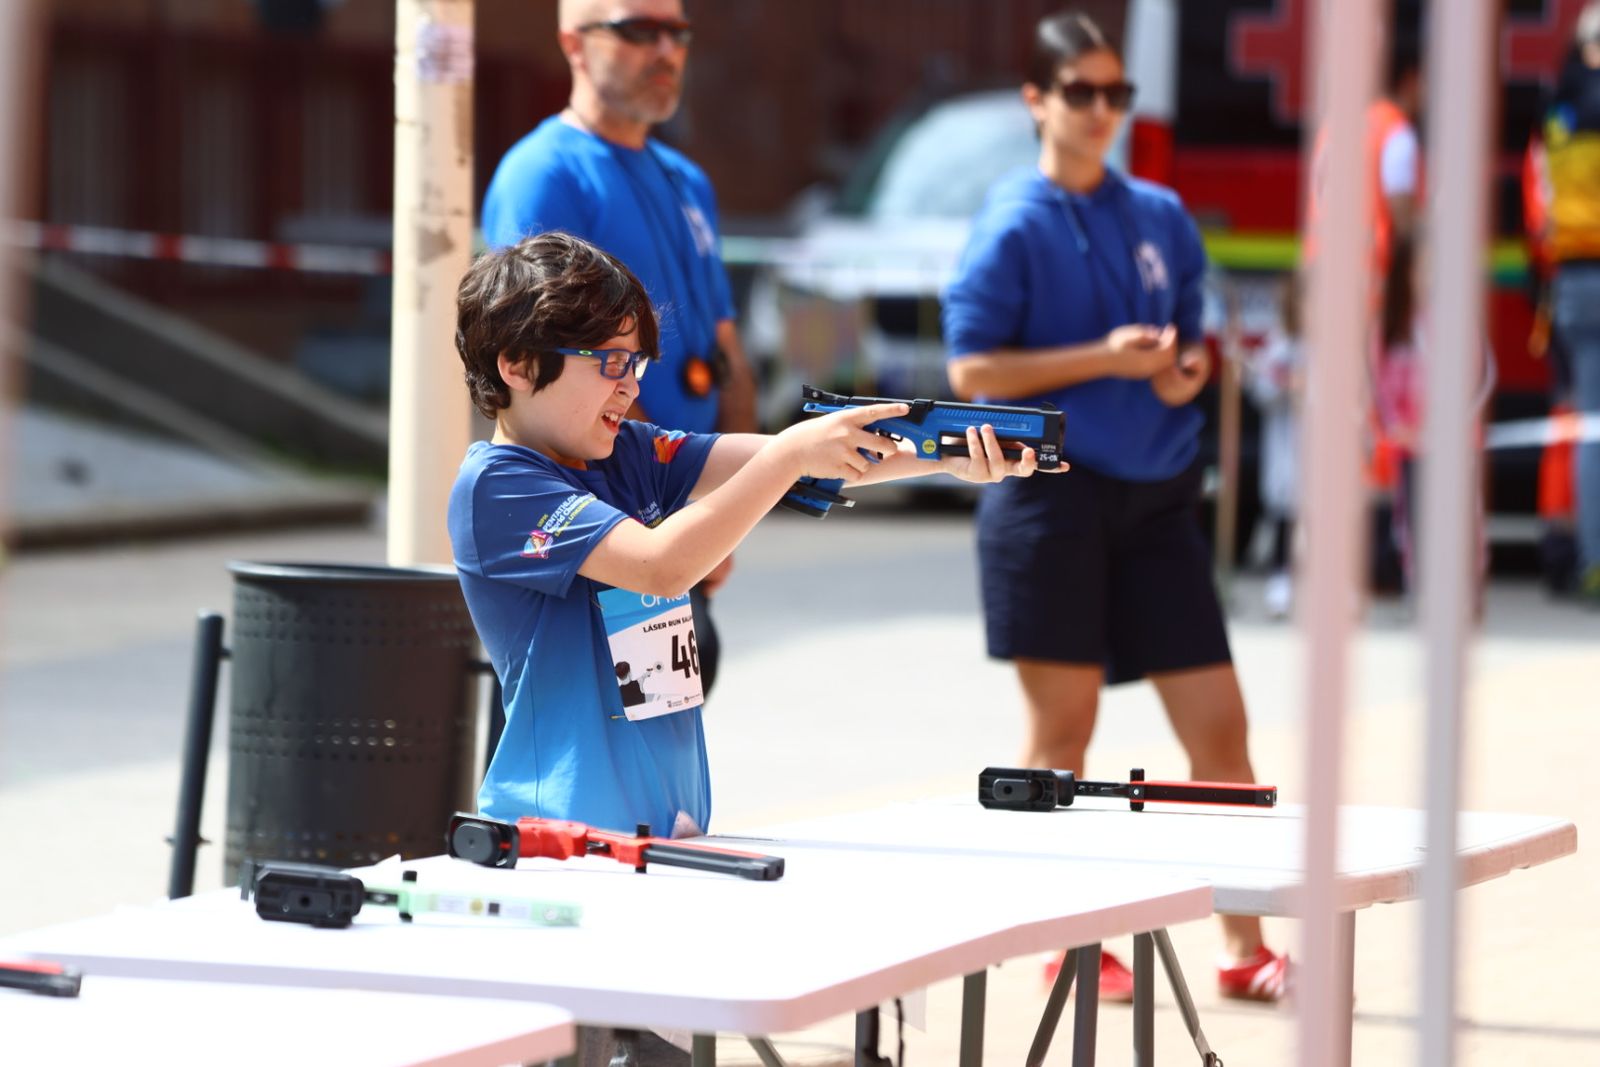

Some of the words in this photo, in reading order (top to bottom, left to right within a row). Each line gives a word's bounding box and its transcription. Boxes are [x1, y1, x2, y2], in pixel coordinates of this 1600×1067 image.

[542, 493, 578, 532] PENTATHLON
[643, 621, 667, 633] LÁSER
[668, 618, 681, 627] RUN
[672, 629, 699, 679] 46
